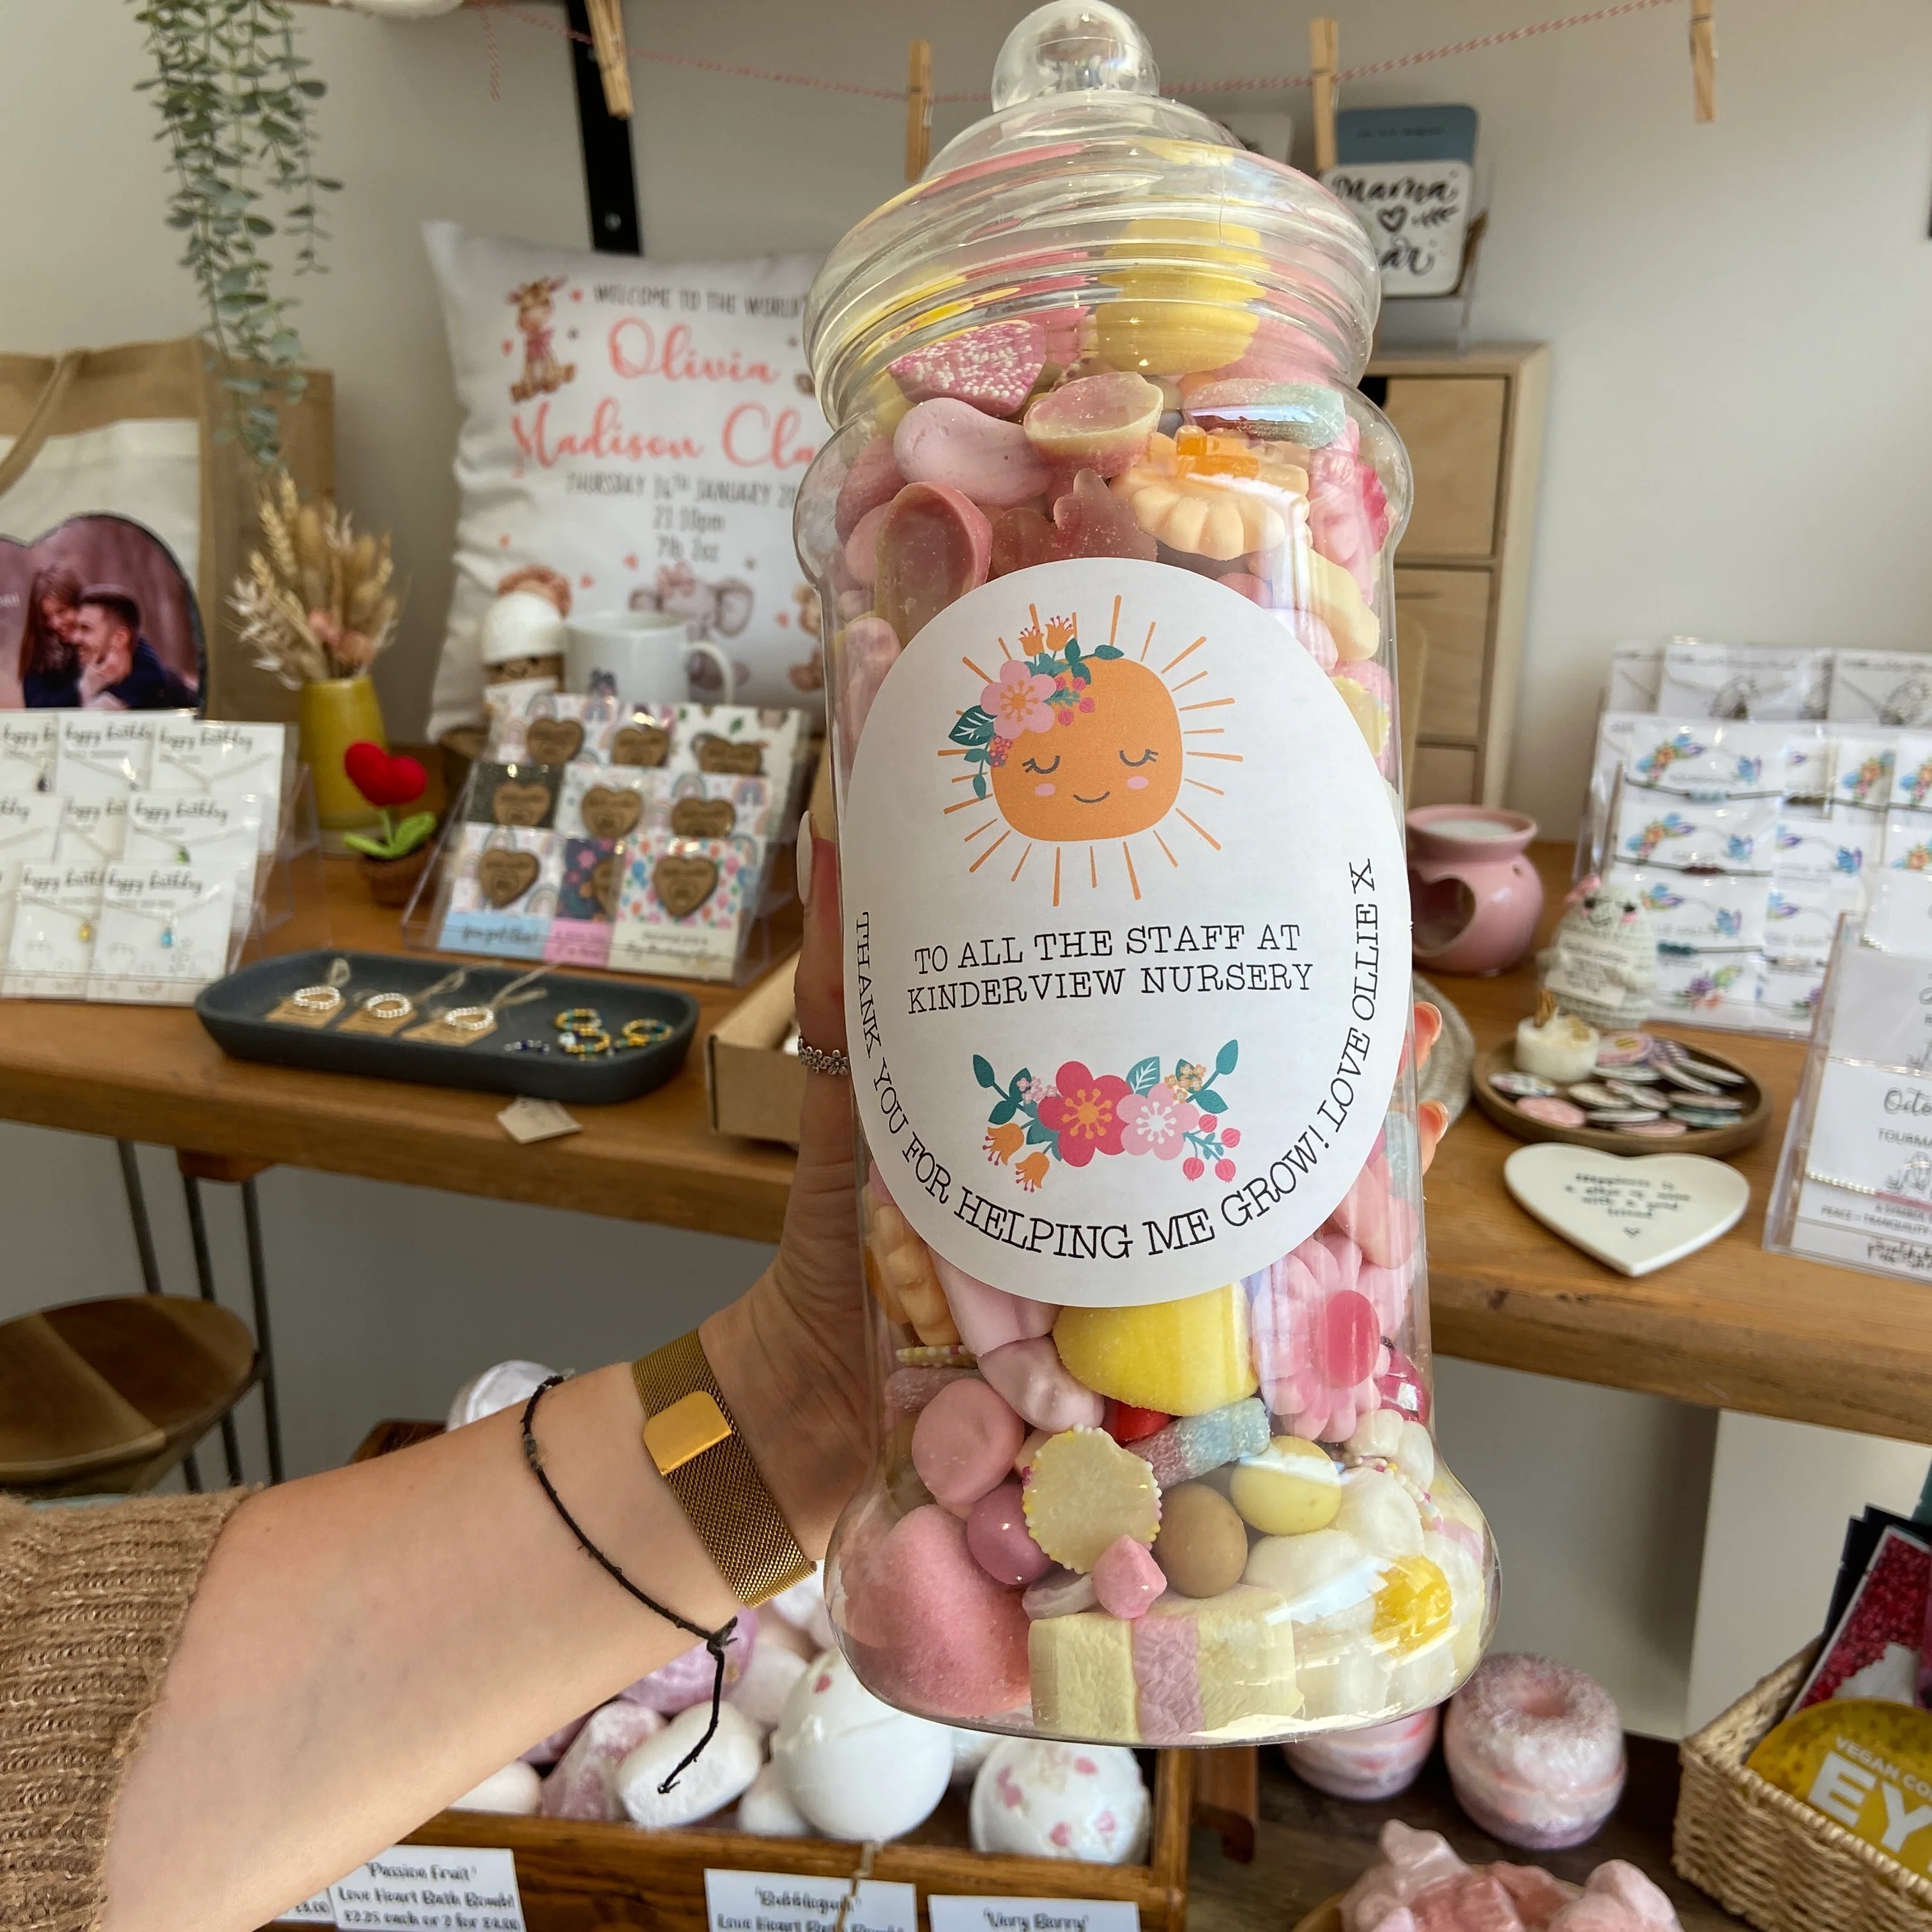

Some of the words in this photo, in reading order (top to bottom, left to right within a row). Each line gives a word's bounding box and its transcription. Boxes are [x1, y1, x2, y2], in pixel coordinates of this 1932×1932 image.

[594, 283, 670, 310] WELCOME
[680, 288, 702, 312] TO
[707, 289, 735, 316] THE
[744, 295, 802, 318] WORLD
[608, 318, 781, 384] Olivia
[511, 397, 702, 478] Madison
[566, 473, 645, 496] THURSDAY
[696, 477, 771, 507] JANUARY
[1349, 857, 1376, 894] X
[914, 945, 948, 975] TO
[957, 937, 1023, 969] ALL
[1034, 930, 1113, 961] THE
[1126, 924, 1245, 954] STAFF
[1257, 923, 1300, 951] AT
[1352, 903, 1379, 1021] OLLIE
[855, 911, 882, 1059] THANK
[907, 967, 1126, 1015] KINDERVIEW
[1140, 962, 1314, 993] NURSERY
[873, 1057, 909, 1135] YOU
[1317, 1027, 1371, 1133] LOVE
[901, 1131, 951, 1205] FOR
[1221, 1124, 1330, 1227] GROW!
[953, 1186, 1133, 1260] HELPING
[1142, 1208, 1216, 1256] ME
[1835, 1733, 1901, 1781] VEGAN
[1903, 1773, 1932, 1804] CO
[1808, 1751, 1932, 1862] EY
[337, 1886, 371, 1902] Love
[374, 1887, 417, 1905] Heart
[420, 1889, 461, 1907] Bath
[383, 1911, 420, 1926] each
